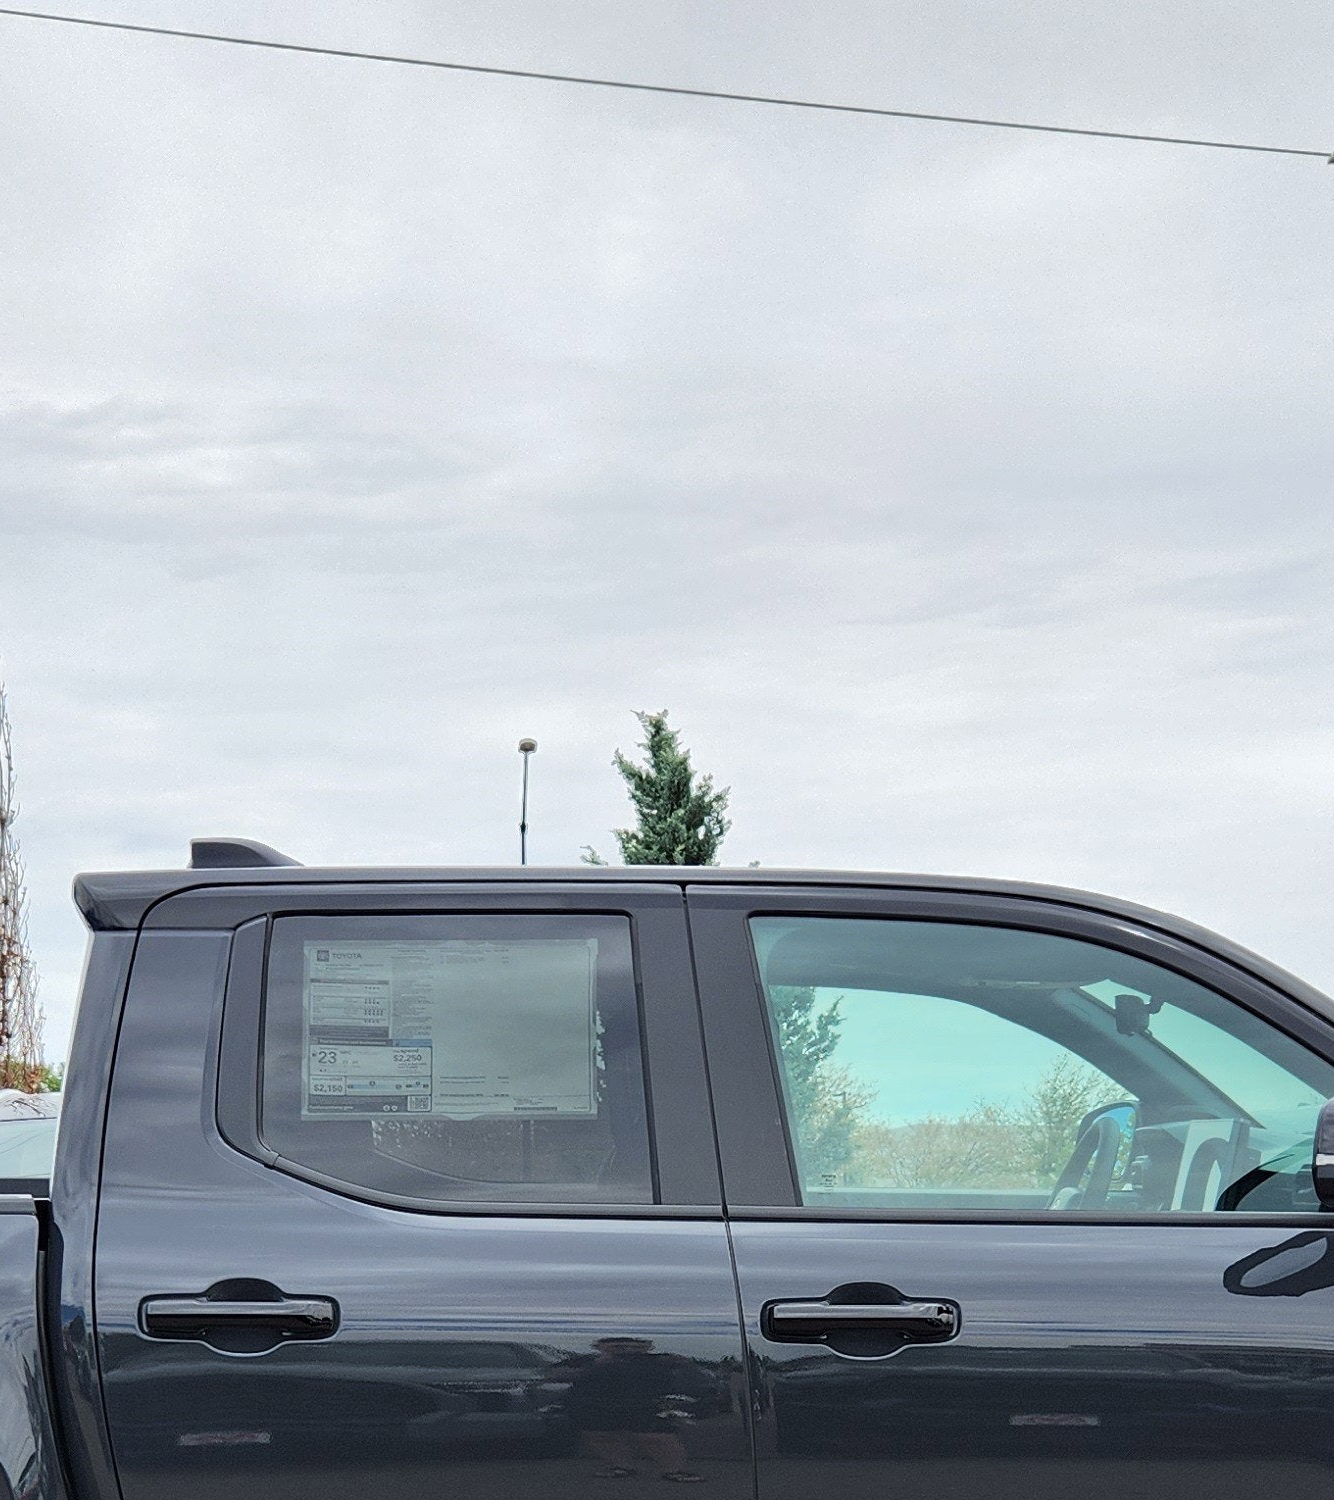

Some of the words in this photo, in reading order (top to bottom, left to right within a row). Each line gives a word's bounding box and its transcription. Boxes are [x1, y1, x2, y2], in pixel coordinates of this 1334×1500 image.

[332, 952, 363, 960] TOYOTA
[318, 1051, 337, 1064] 23
[313, 1084, 343, 1093] $2,150
